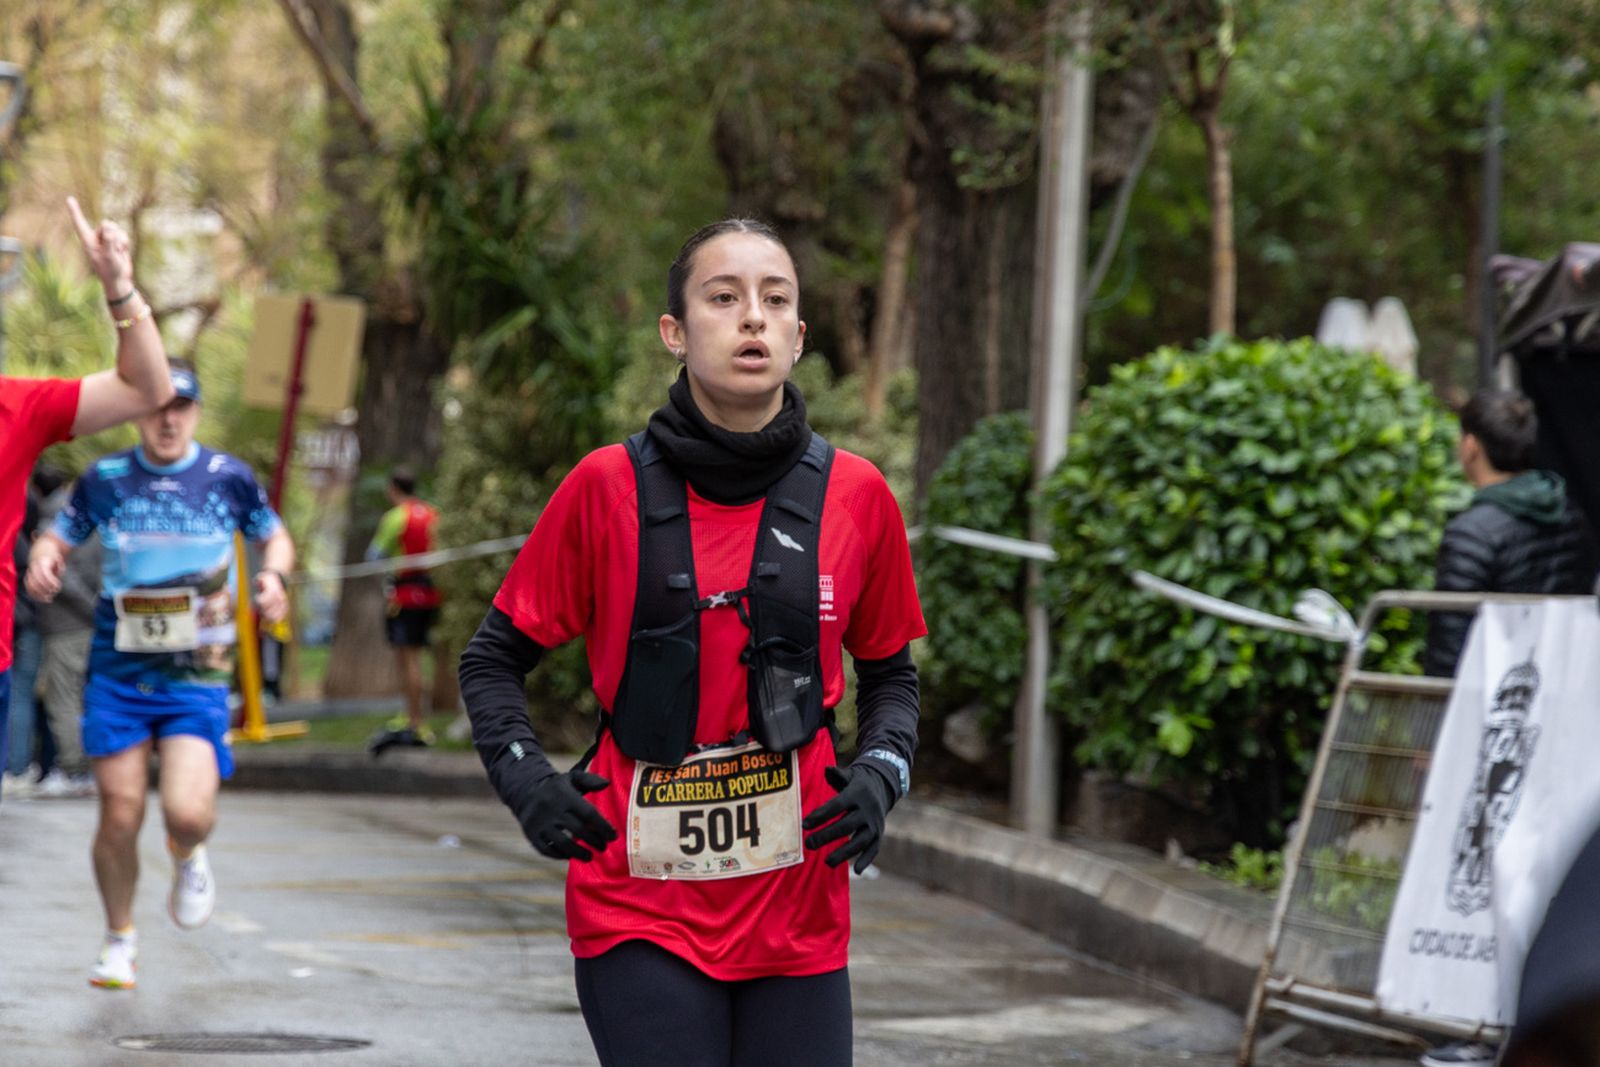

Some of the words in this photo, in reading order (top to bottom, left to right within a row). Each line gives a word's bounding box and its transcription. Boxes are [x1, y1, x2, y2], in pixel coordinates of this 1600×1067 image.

[705, 759, 738, 778] Juan
[742, 753, 783, 772] Bosco
[643, 786, 652, 804] V
[656, 781, 725, 803] CARRERA
[728, 768, 788, 796] POPULAR
[679, 802, 761, 856] 504
